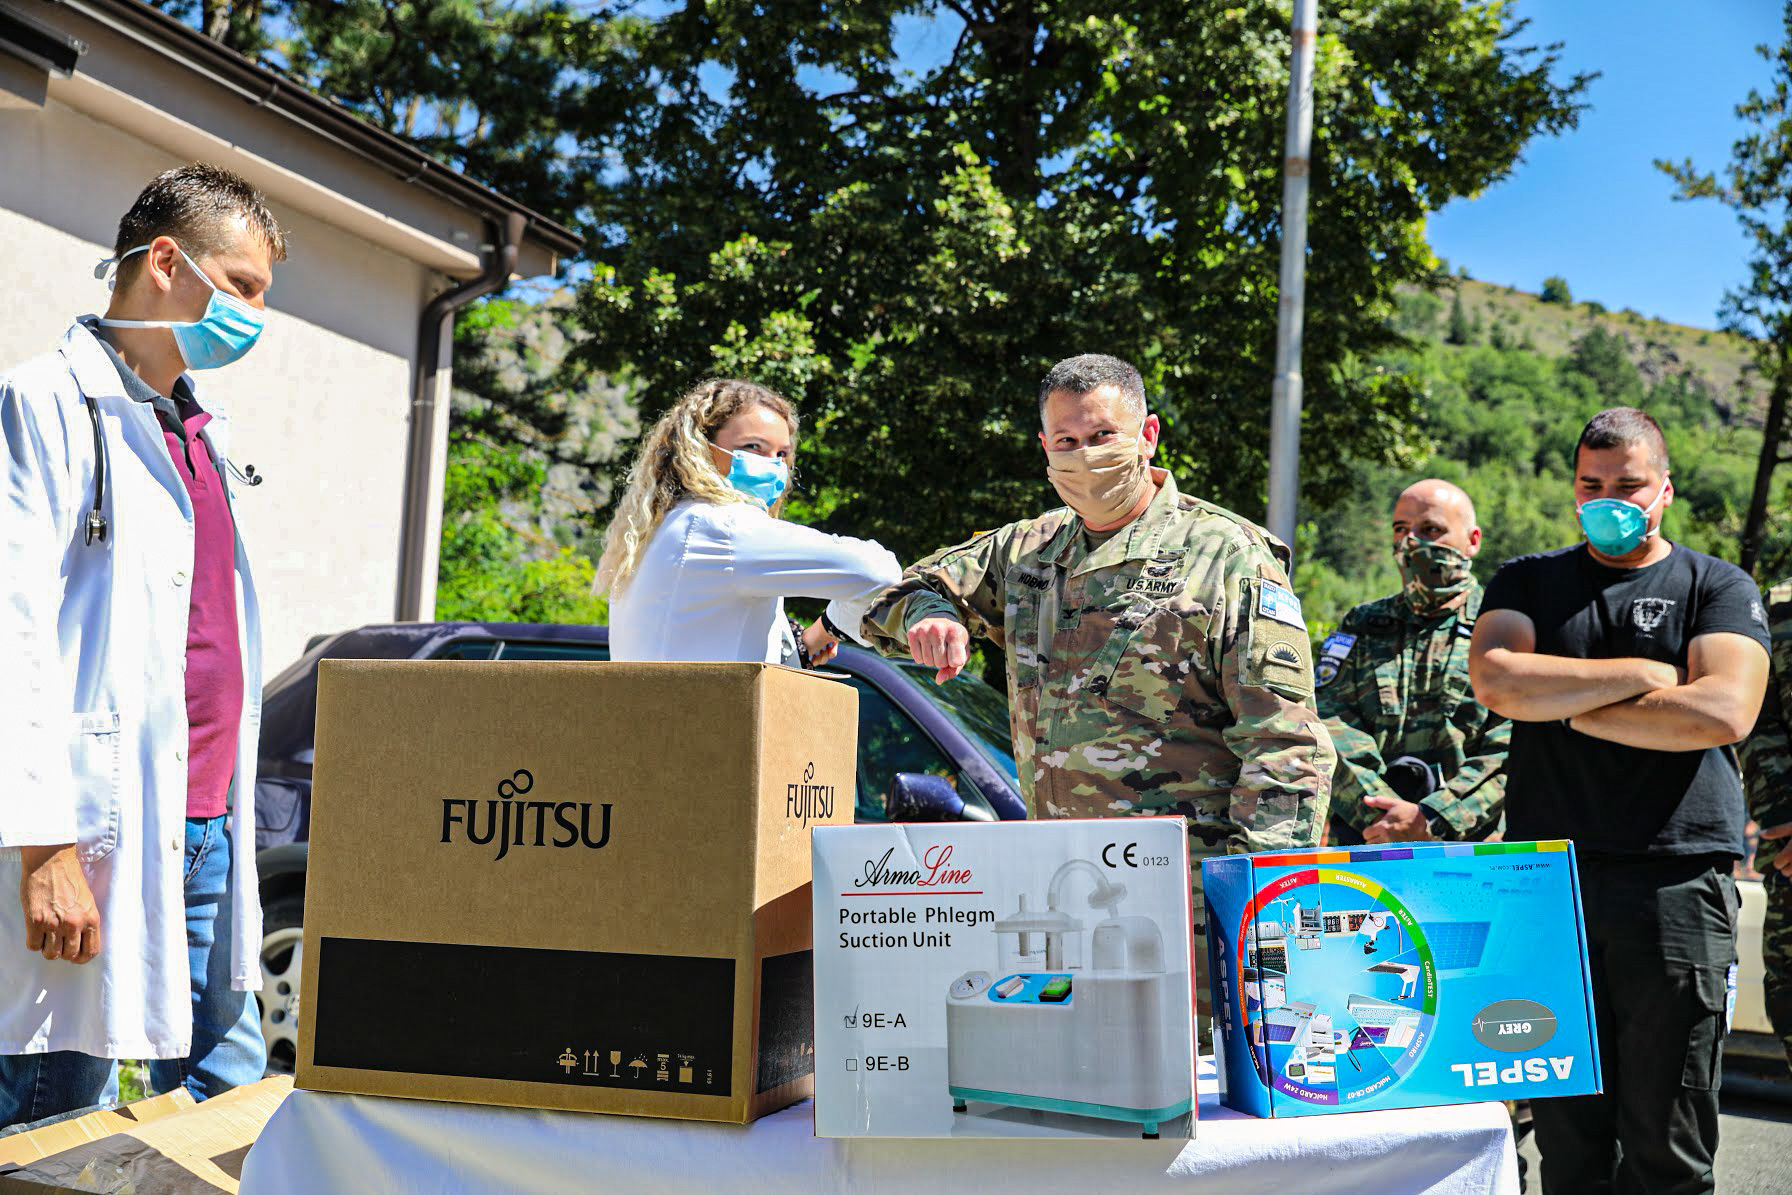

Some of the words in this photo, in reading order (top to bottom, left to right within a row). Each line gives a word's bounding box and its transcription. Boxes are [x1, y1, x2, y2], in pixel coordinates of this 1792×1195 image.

[786, 782, 834, 830] FUJITSU
[440, 797, 613, 861] FUJITSU
[1142, 856, 1170, 867] 0123
[839, 907, 917, 925] Portable
[925, 906, 996, 927] Phlegm
[839, 931, 908, 948] Suction
[912, 931, 952, 948] Unit
[1424, 960, 1434, 998] CardioTEST
[1217, 935, 1232, 1041] ASPEL
[862, 1013, 907, 1028] 9E-A
[1497, 1021, 1532, 1035] GREY
[660, 1061, 667, 1071] 5
[865, 1056, 910, 1071] 9E-B
[1450, 1055, 1575, 1087] ASPEL
[1283, 1083, 1300, 1096] 24W
